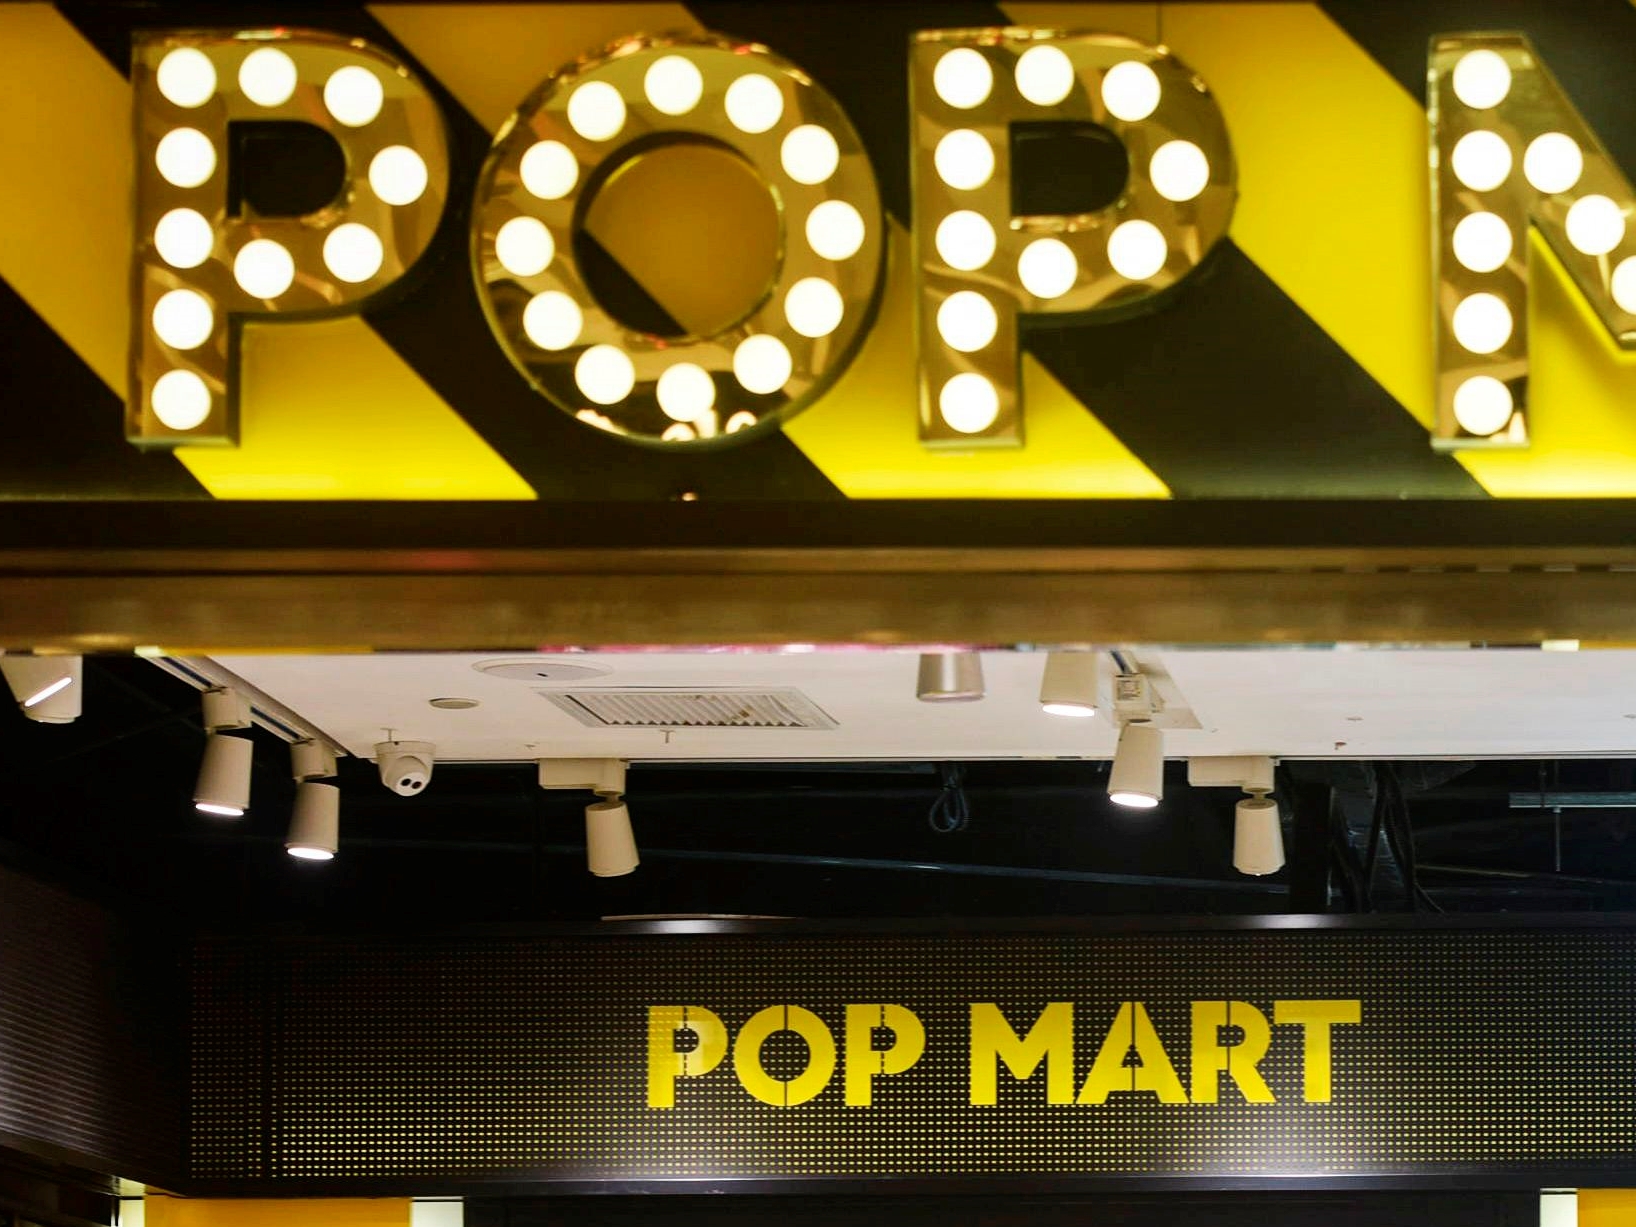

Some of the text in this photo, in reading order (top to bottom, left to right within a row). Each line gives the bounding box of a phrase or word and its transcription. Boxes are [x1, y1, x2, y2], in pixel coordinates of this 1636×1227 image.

[124, 24, 1240, 449] POP
[646, 999, 1363, 1109] POP MART
